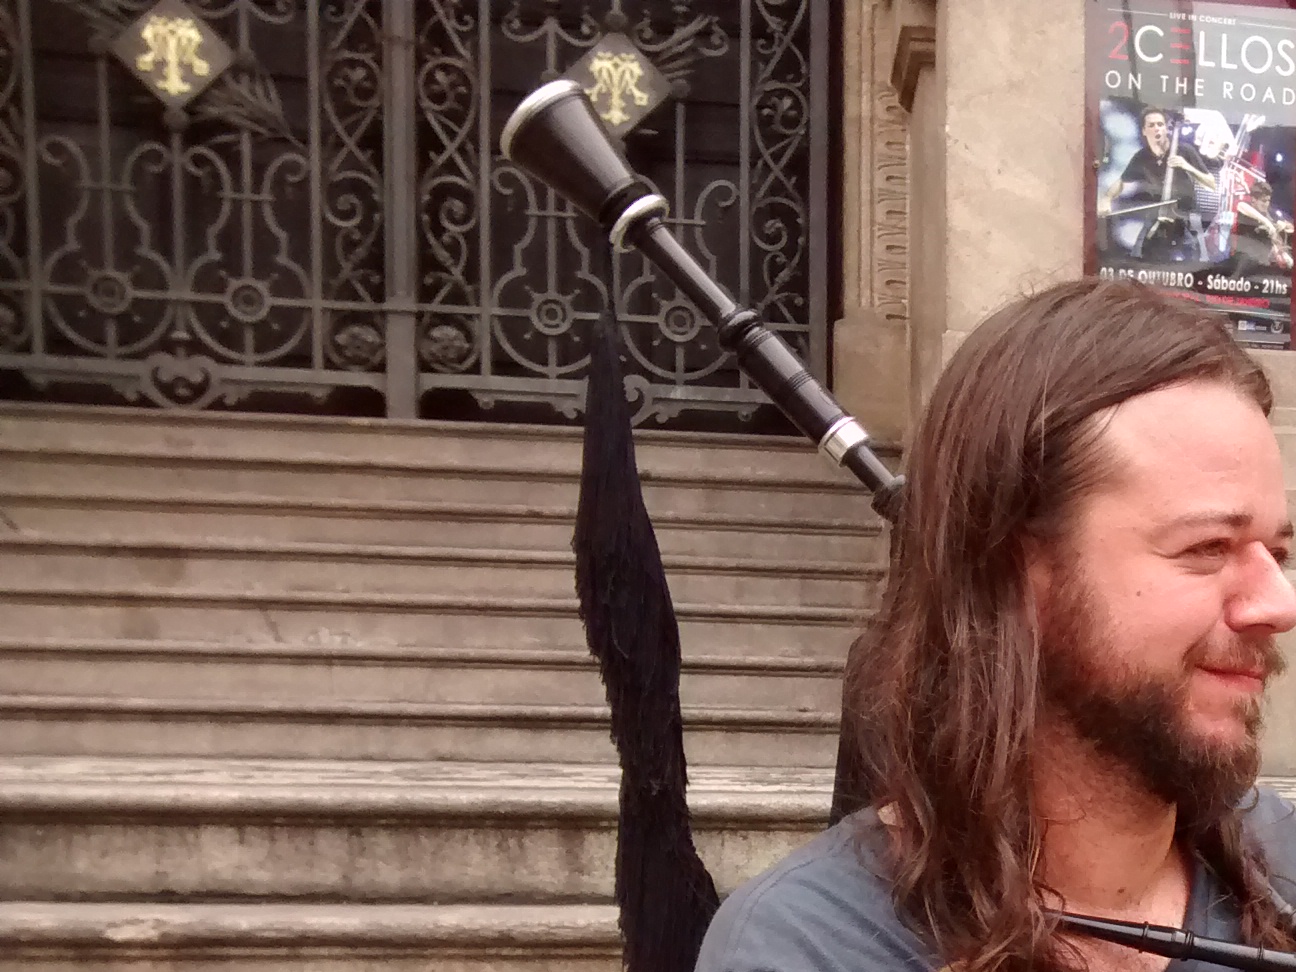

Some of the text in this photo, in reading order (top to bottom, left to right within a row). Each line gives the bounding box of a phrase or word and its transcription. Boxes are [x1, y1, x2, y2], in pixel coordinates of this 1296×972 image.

[1169, 12, 1236, 25] LIVE IN CONCERT
[1108, 21, 1296, 76] 2CELLOS
[1105, 70, 1296, 105] ON THE ROAD
[1138, 270, 1194, 288] OUTUBRO
[1207, 273, 1251, 292] Sábado
[1262, 278, 1288, 294] 21hs
